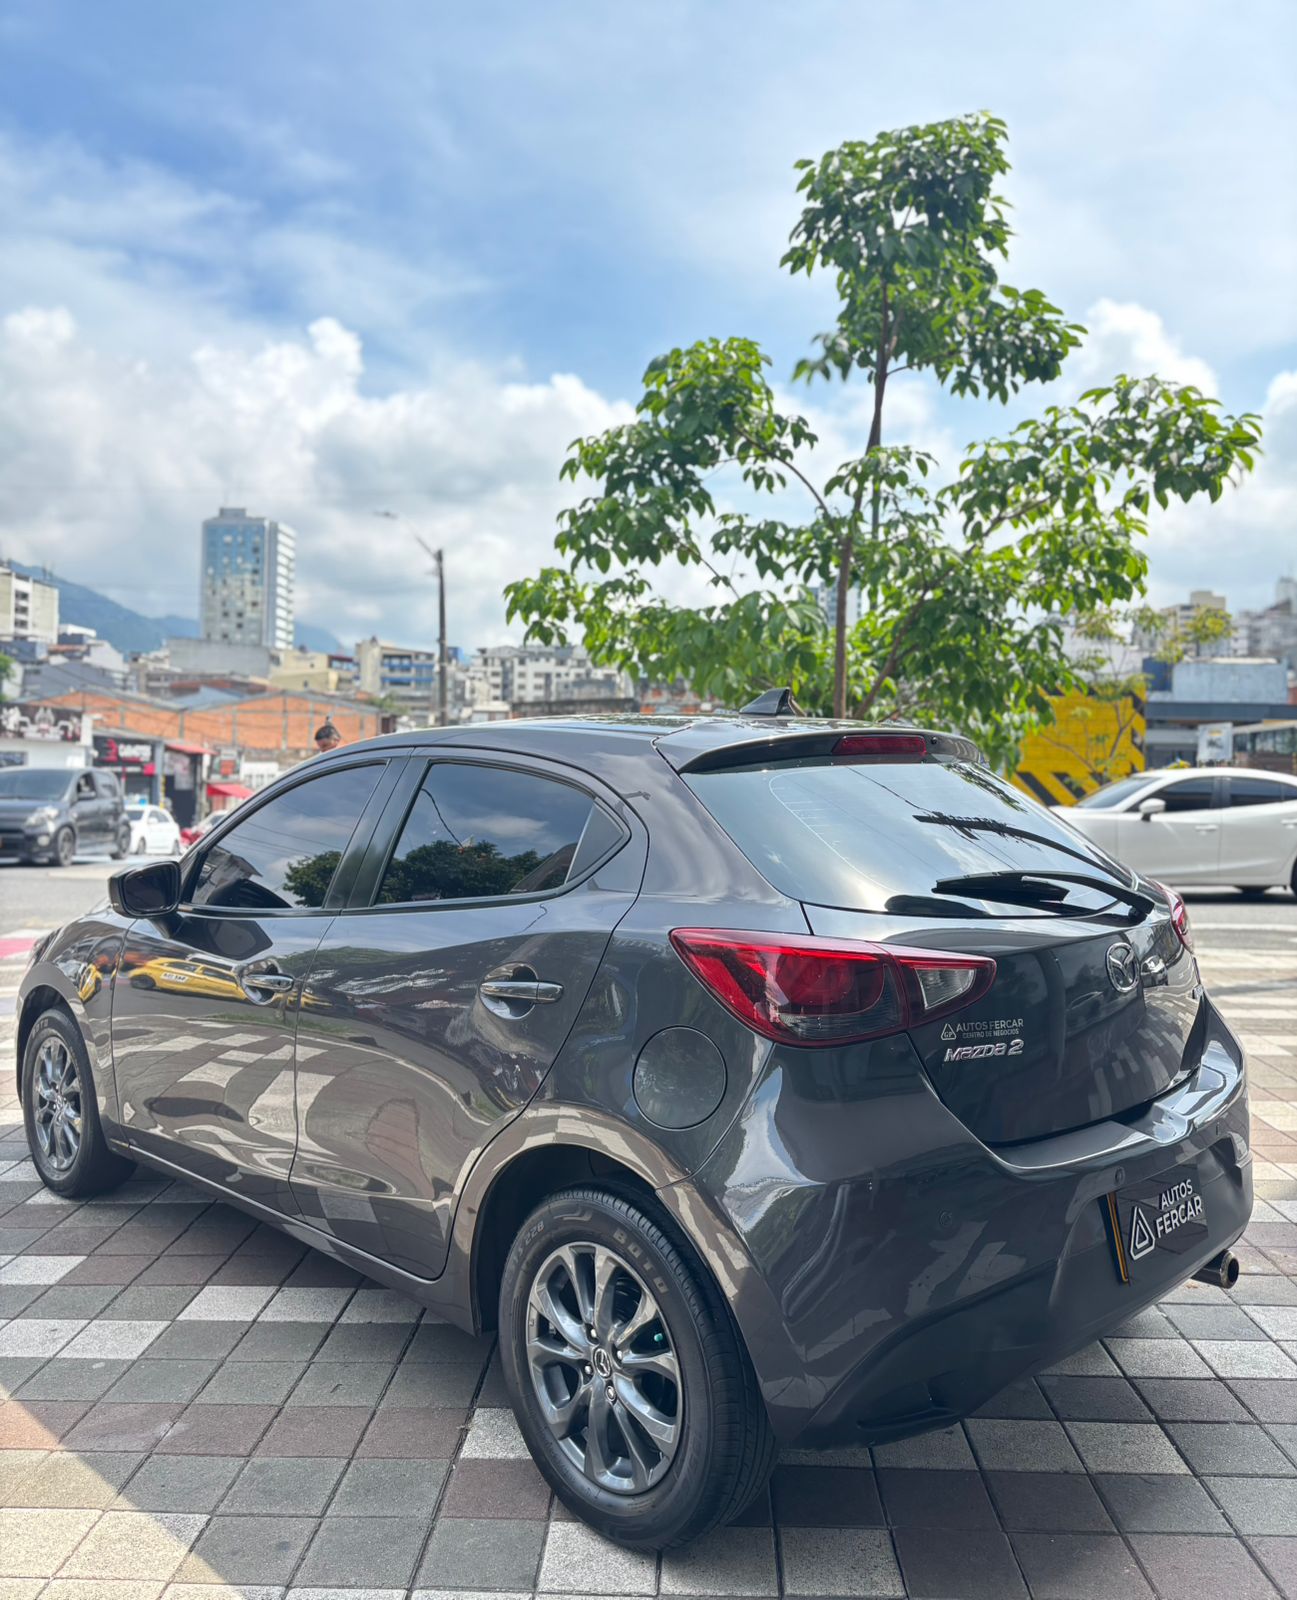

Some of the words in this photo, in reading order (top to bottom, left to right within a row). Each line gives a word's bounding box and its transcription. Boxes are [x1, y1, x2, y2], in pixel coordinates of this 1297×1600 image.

[956, 1022, 987, 1032] AUTOS
[990, 1019, 1023, 1029] FERCAR
[993, 1028, 1019, 1036] NEGOCIOS
[1007, 1038, 1024, 1056] 2
[524, 1220, 545, 1245] 228
[612, 1228, 669, 1294] BOTO
